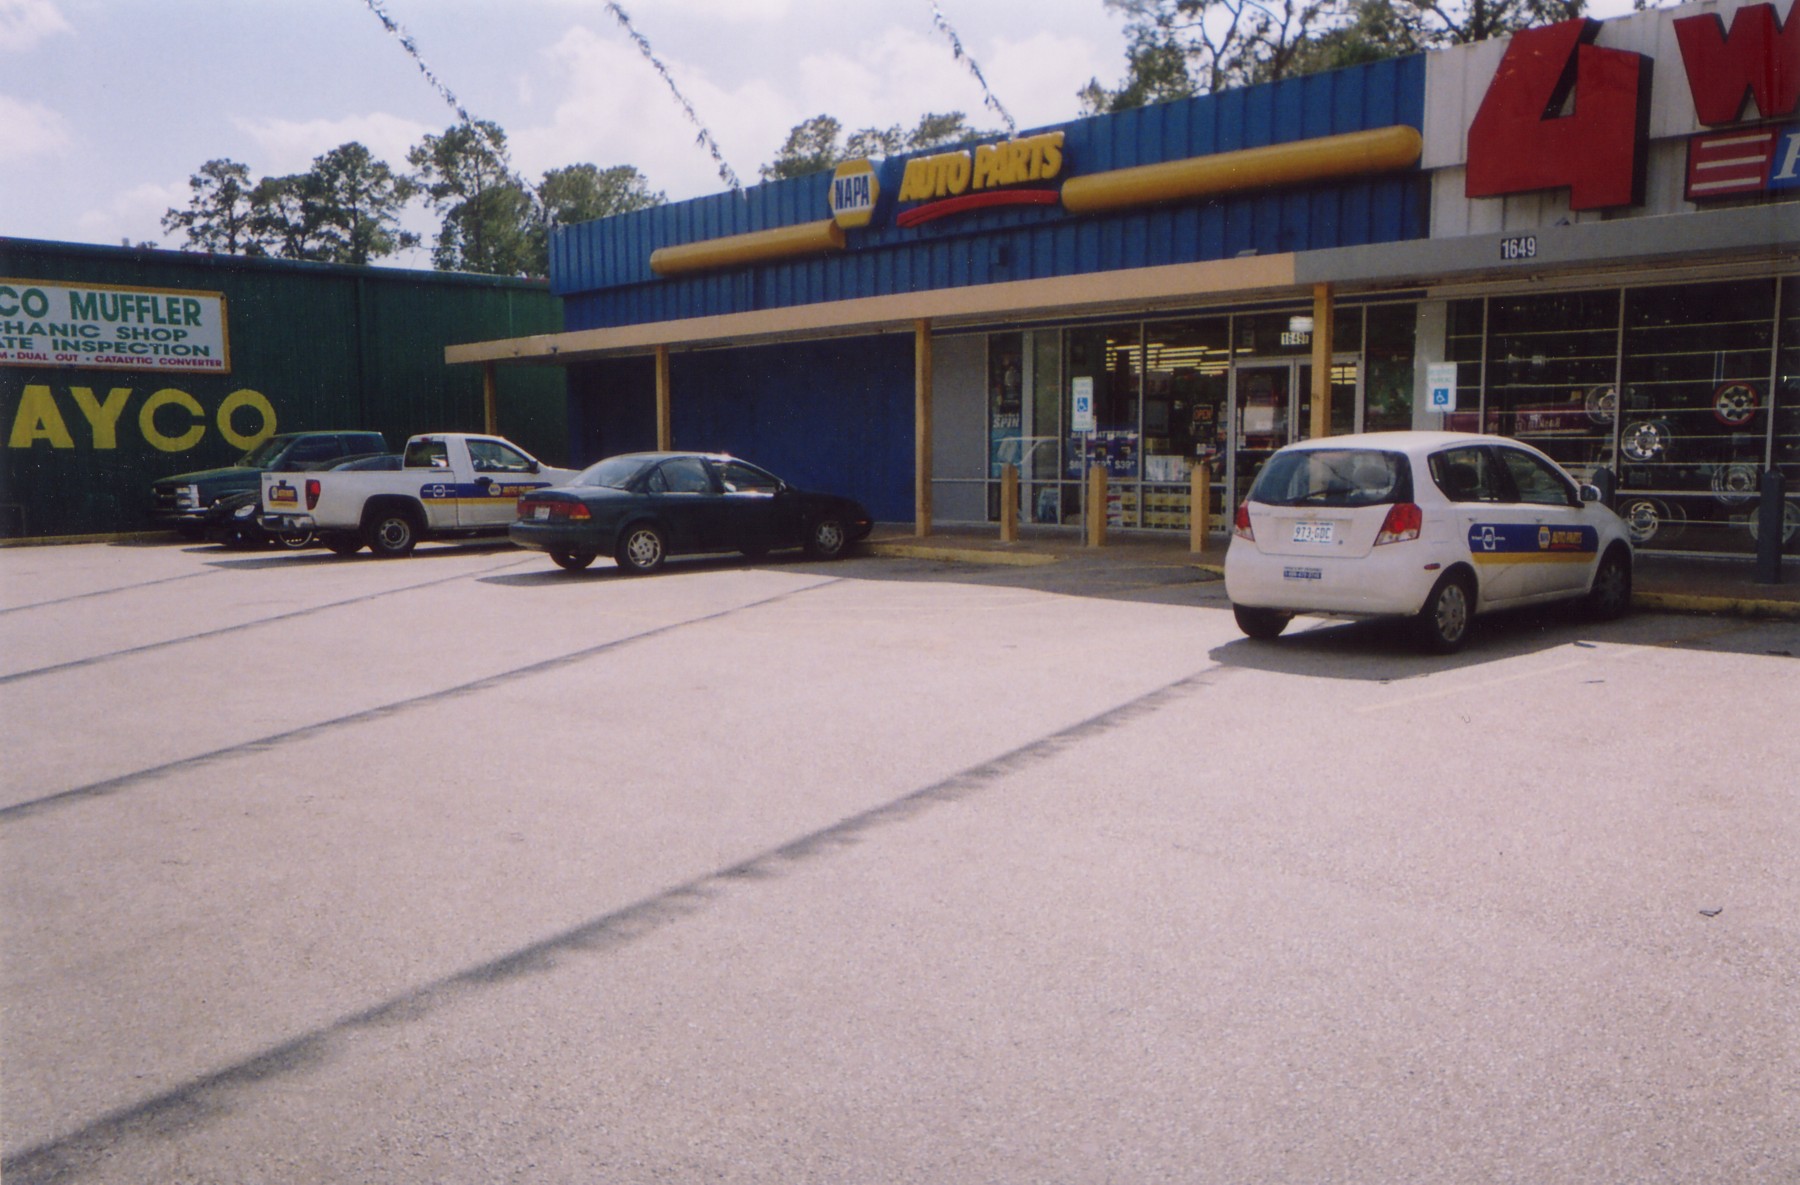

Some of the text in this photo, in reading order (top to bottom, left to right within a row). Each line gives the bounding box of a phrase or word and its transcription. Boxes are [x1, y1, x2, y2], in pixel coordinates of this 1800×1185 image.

[1465, 17, 1653, 210] 4
[835, 130, 1065, 210] NAPA AUTO PARTS
[1502, 237, 1536, 258] 1649
[69, 291, 202, 326] MUFFLER
[0, 320, 188, 342] HANIC SHOP
[52, 338, 209, 357] INSPECTION
[17, 352, 48, 361] DUAL
[55, 353, 78, 361] OUT
[95, 355, 153, 365] CATALYTIC
[159, 357, 222, 367] CONVERTER
[1295, 526, 1312, 539] 973
